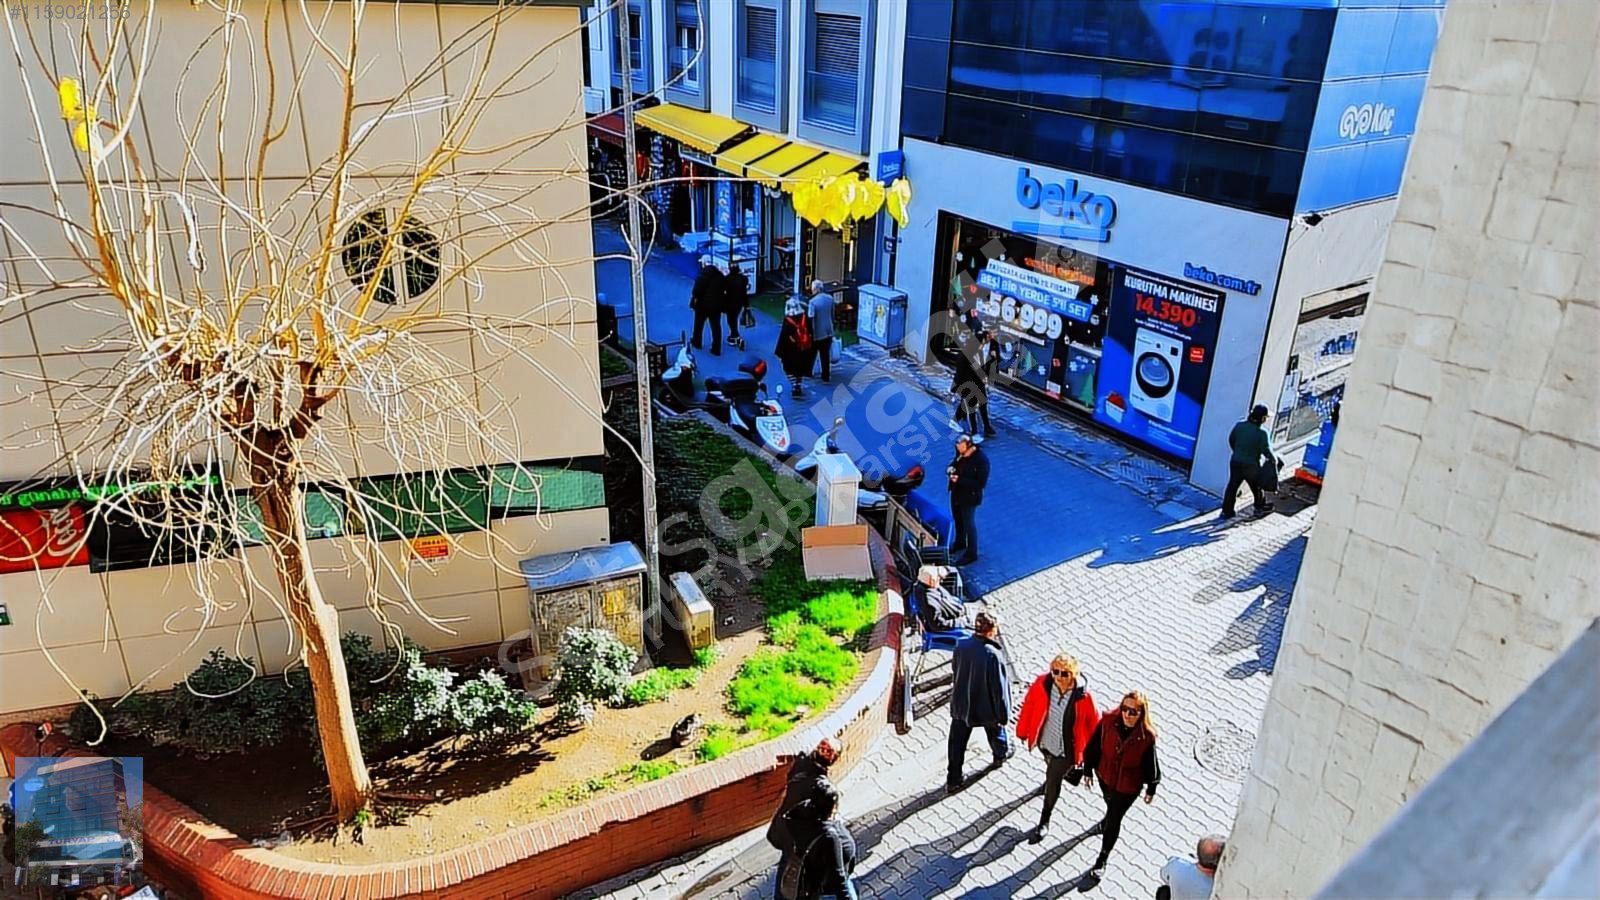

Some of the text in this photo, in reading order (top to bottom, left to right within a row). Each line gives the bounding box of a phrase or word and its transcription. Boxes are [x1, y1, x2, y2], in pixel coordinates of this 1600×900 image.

[1370, 102, 1395, 136] Koç
[1016, 167, 1117, 230] beko
[1124, 274, 1168, 299] KURUTMA
[1169, 287, 1218, 313] MAKİNESİ
[1183, 262, 1261, 296] beko.com.tr
[1019, 286, 1051, 306] YERDE
[1068, 302, 1089, 318] SET
[1135, 292, 1197, 327] 14.390
